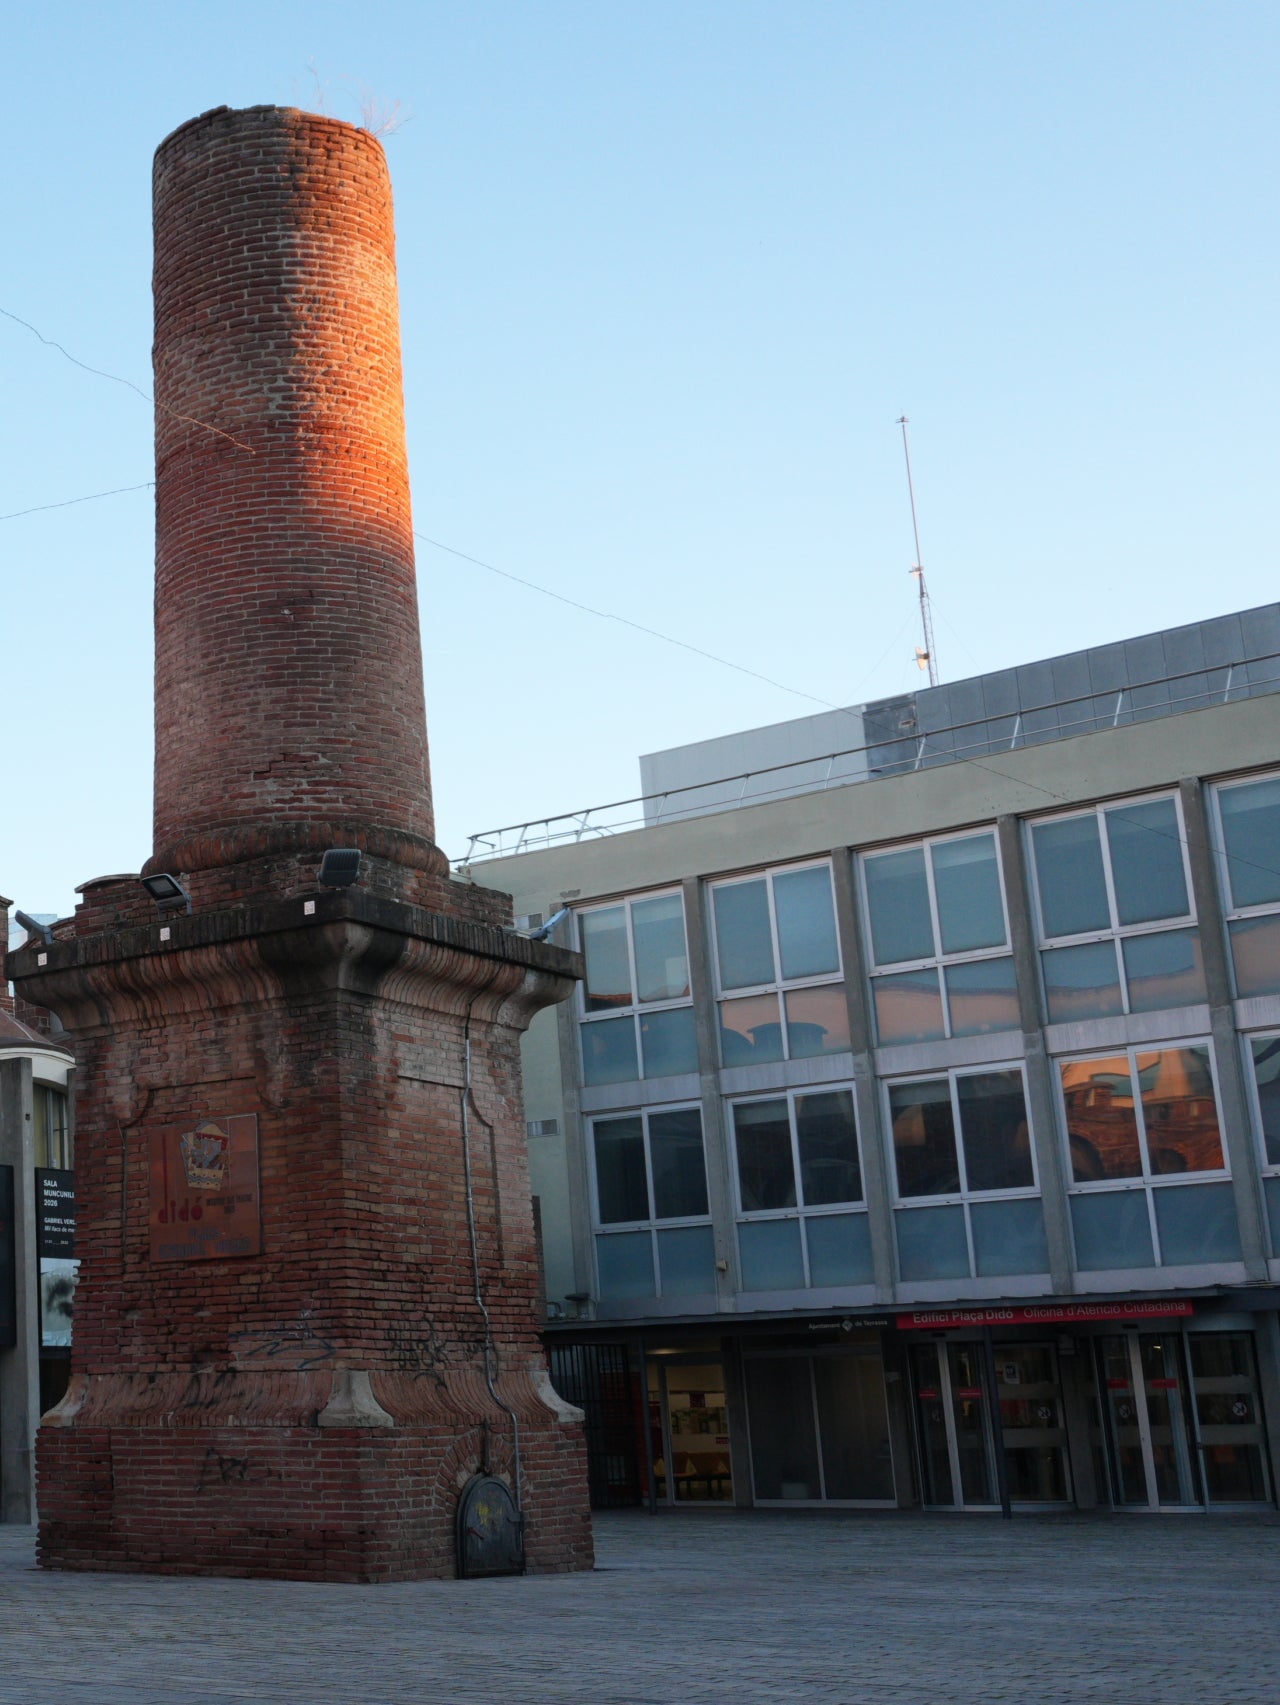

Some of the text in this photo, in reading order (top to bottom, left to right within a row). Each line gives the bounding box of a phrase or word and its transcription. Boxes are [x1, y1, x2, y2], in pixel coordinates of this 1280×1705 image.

[913, 1299, 1186, 1324] Edifici Plaça Didó Oficina d'Atenció Ciutadana
